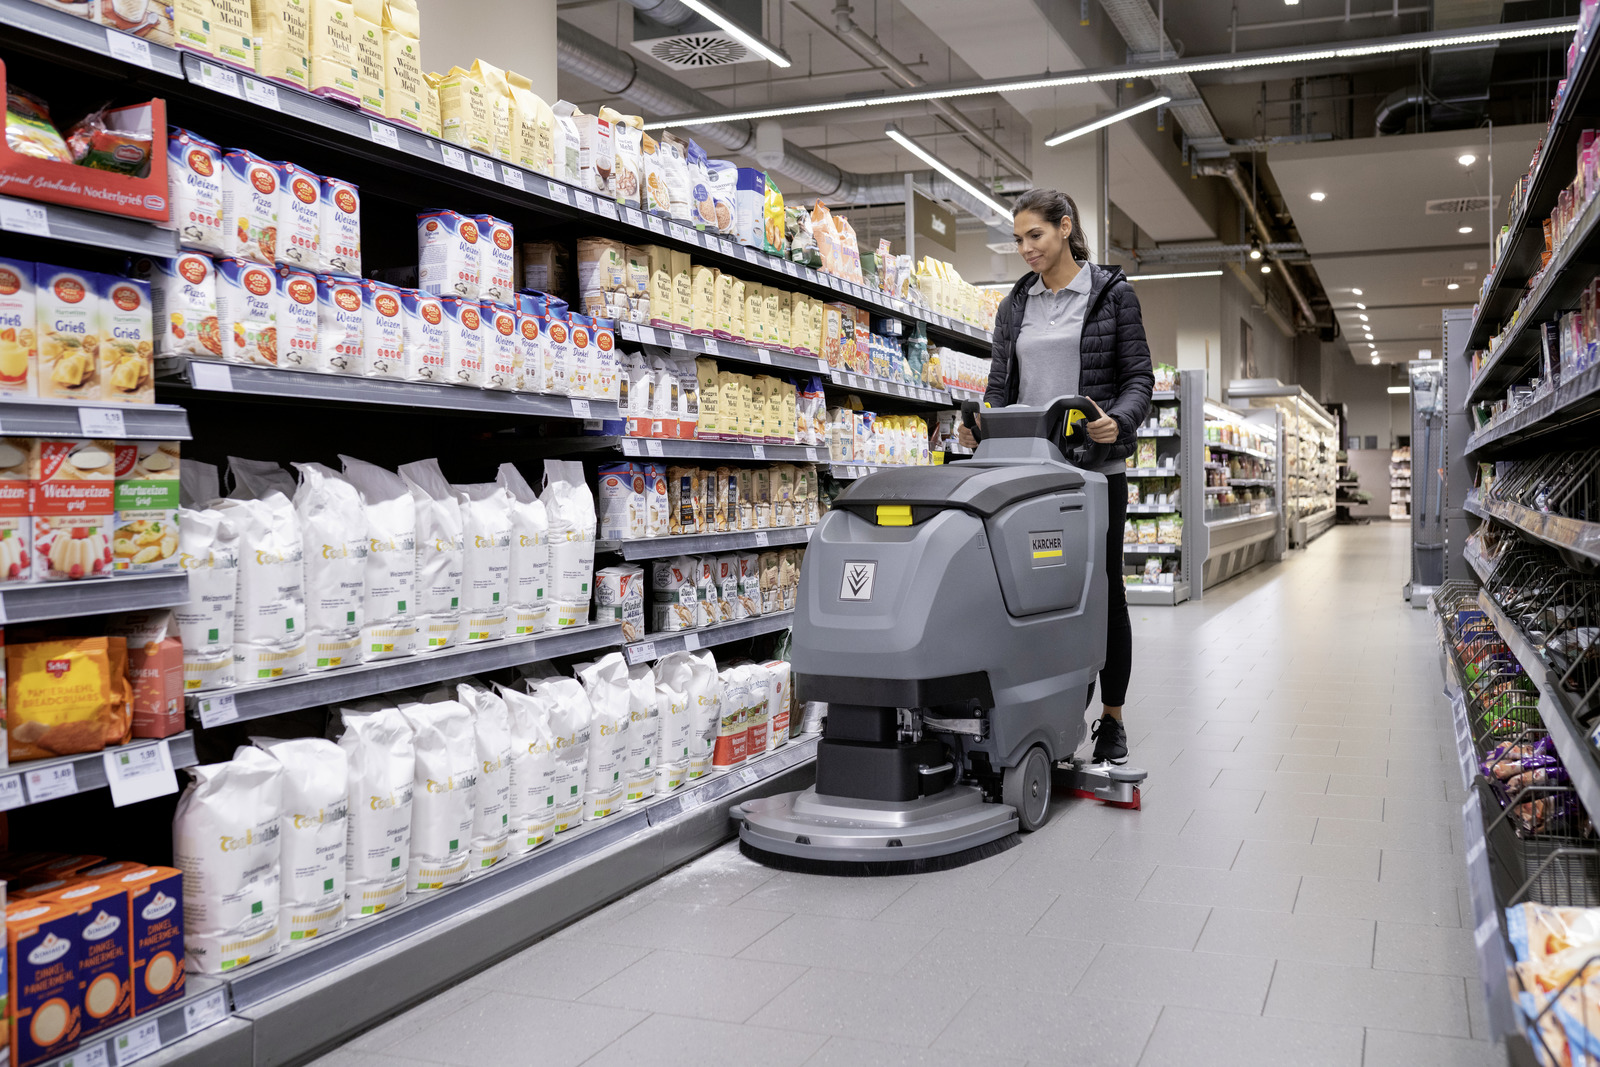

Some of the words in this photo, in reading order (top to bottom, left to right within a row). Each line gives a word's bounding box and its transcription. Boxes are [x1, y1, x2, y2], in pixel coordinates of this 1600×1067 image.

[220, 12, 243, 28] Mehl
[283, 11, 307, 28] Dinkel
[287, 24, 305, 40] Mehl
[327, 26, 351, 44] Dinkel
[332, 38, 350, 52] Mehl
[359, 43, 382, 60] Weizen
[363, 65, 380, 80] Mehl
[397, 57, 418, 75] Weizen
[393, 67, 421, 85] Vollkorn
[401, 80, 416, 94] Mehl
[187, 174, 219, 193] Weizen
[255, 171, 272, 183] GOLD
[83, 187, 143, 206] Nockerlgrieß
[196, 188, 213, 200] Mehl
[252, 192, 272, 208] Pizza
[255, 206, 270, 216] Mehl
[292, 200, 318, 218] Weizen
[297, 214, 312, 225] Mehl
[335, 211, 358, 226] Weizen
[341, 224, 354, 234] Mehl
[459, 242, 479, 255] Weizen
[492, 248, 513, 260] Weizen
[465, 253, 476, 261] Mehl
[498, 259, 510, 268] Mehl
[249, 274, 268, 285] GOLD
[183, 283, 206, 298] Pizza
[292, 283, 313, 294] GOLD
[246, 295, 269, 310] Pizza
[378, 298, 395, 308] GOLD
[250, 308, 267, 319] Mehl
[289, 303, 317, 318] Weizen
[424, 306, 440, 317] GOLD
[0, 313, 22, 327] rieß
[296, 316, 311, 325] Mehl
[336, 311, 362, 325] Weizen
[376, 316, 401, 329] Weizen
[55, 320, 86, 334] Grieß
[113, 327, 141, 340] Grieß
[346, 323, 359, 332] Mehl
[383, 327, 396, 336] Mehl
[422, 324, 443, 336] Weizen
[429, 335, 440, 345] Mehl
[461, 329, 481, 342] Weizen
[495, 335, 515, 346] Weizen
[466, 339, 477, 348] Mehl
[500, 345, 511, 354] Mehl
[573, 348, 589, 358] Dinkel
[597, 351, 614, 361] Dinkel
[0, 485, 27, 498] eizen-
[41, 484, 113, 498] Weichweizen-
[119, 484, 168, 496] Hartweizen
[1032, 538, 1062, 550] KÄRCHER
[624, 599, 641, 612] Dinkel
[626, 609, 640, 618] MEHL
[130, 669, 160, 678] RMEHL
[23, 695, 99, 708] BREADCRUMBS
